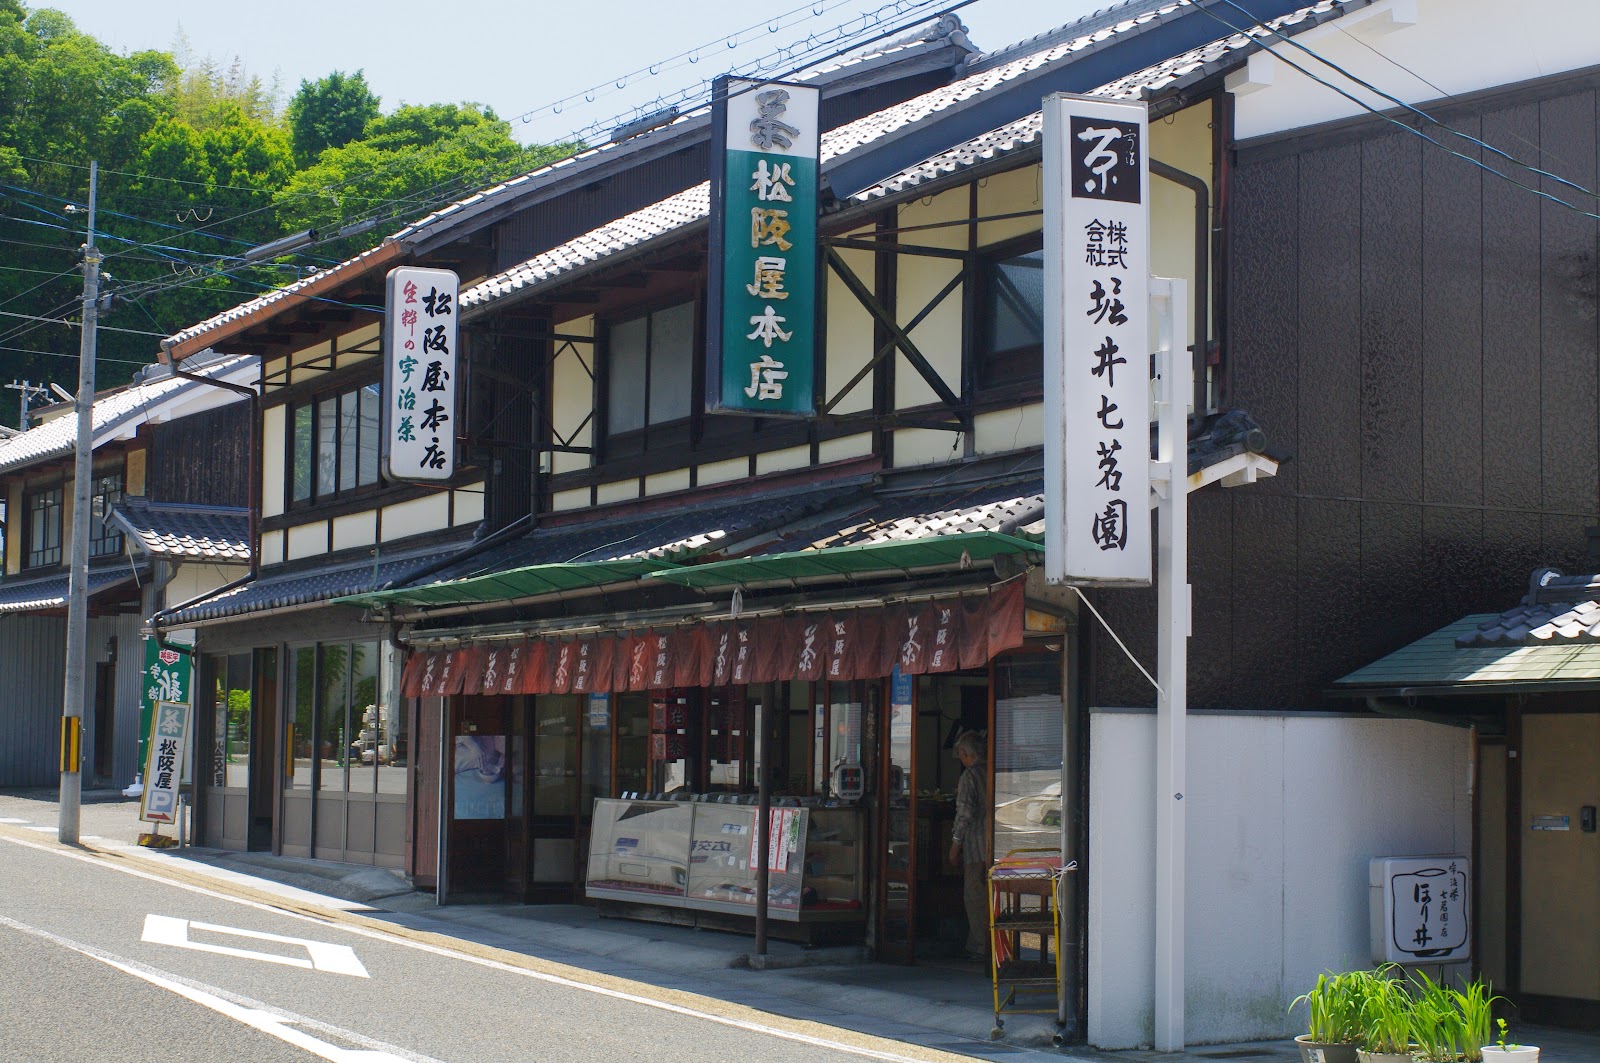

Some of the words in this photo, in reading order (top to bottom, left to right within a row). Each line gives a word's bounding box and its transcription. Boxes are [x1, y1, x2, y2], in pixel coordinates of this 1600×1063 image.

[749, 88, 800, 150] 茶
[744, 159, 796, 401] 松阪屋本店
[420, 286, 452, 470] 松阪屋本店
[1086, 277, 1129, 551] 堀井七茗園
[653, 636, 667, 685] 松阪屋
[734, 630, 748, 680] 松阪屋
[830, 621, 846, 676] 松阪屋
[931, 608, 951, 667] 松阪屋
[504, 648, 520, 691] 松阪屋
[575, 644, 590, 689] 松阪屋
[160, 709, 183, 735] 茶
[154, 738, 177, 790] 松阪屋
[151, 792, 171, 810] P
[1413, 883, 1432, 947] ほり井
